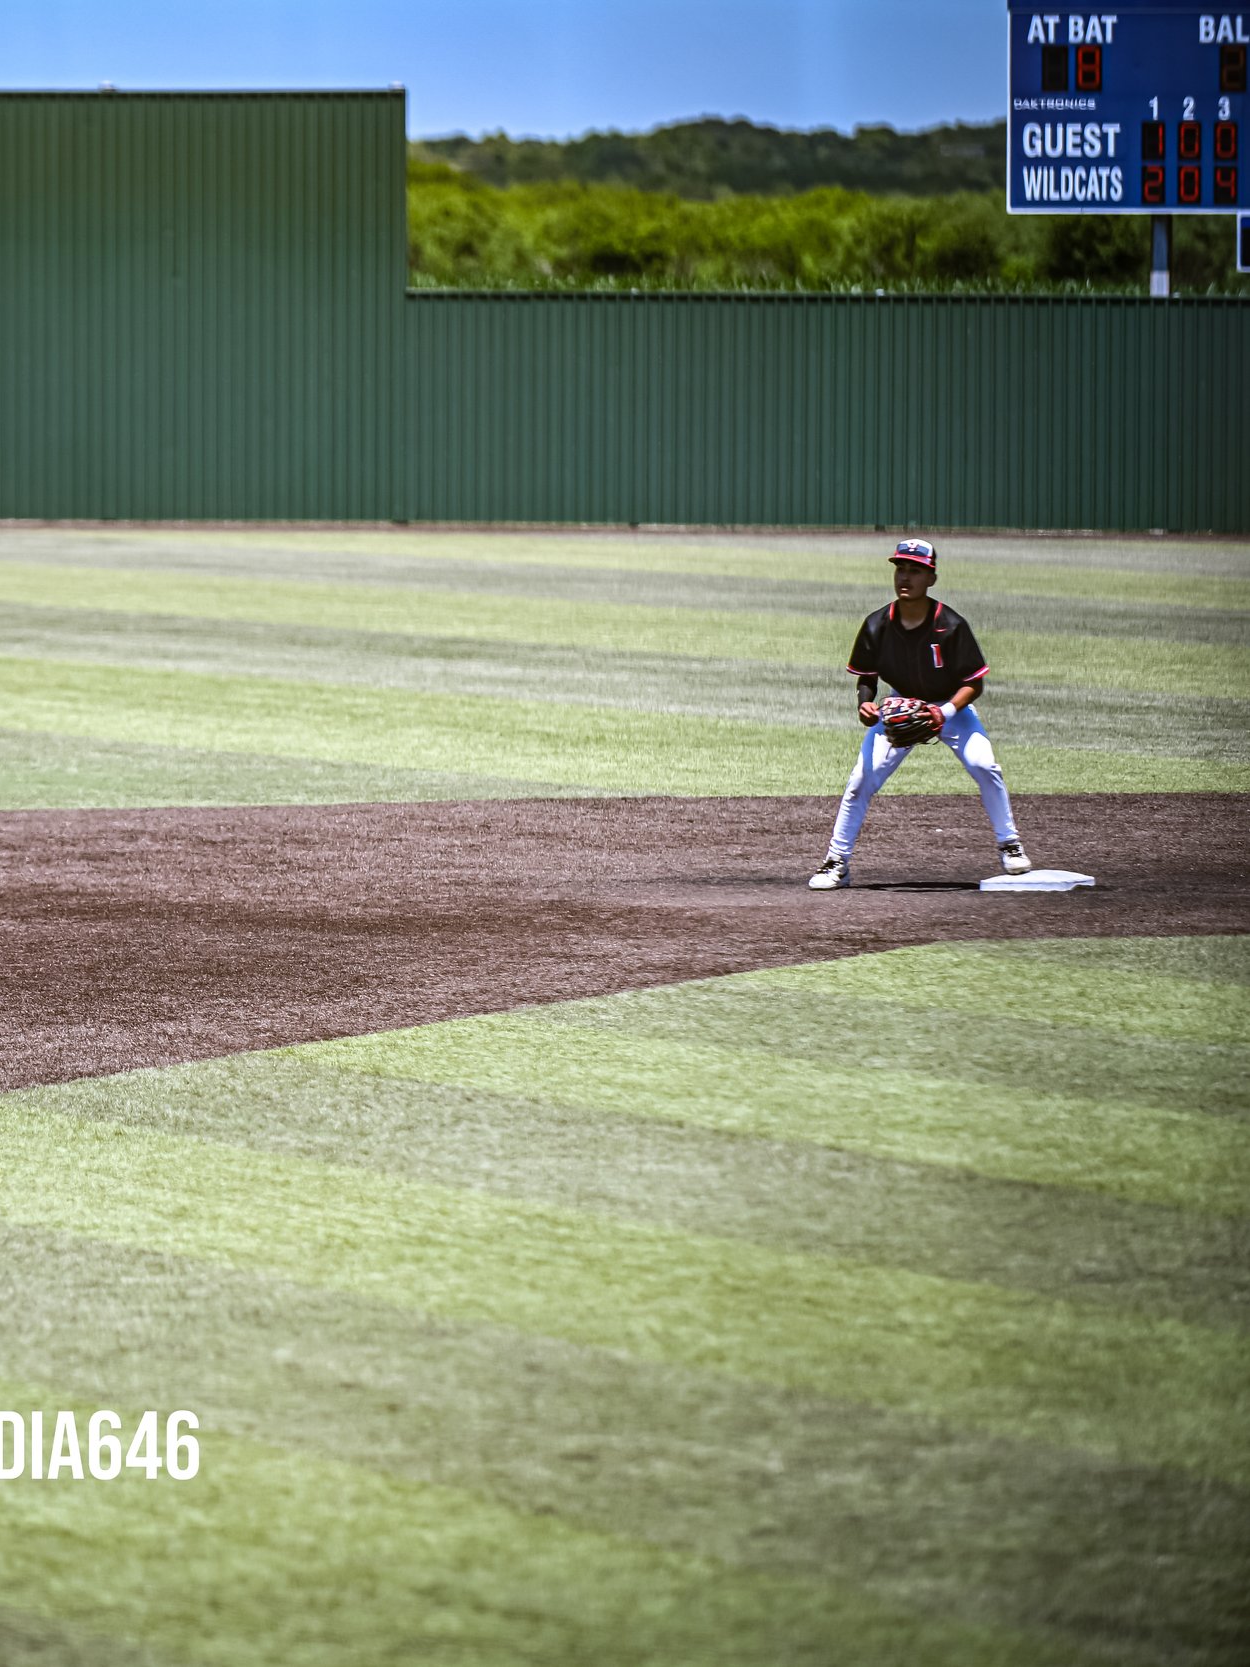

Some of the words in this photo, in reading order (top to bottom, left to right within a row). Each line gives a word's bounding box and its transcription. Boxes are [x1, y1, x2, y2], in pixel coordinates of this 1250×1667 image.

[1027, 15, 1060, 44] AT
[1068, 15, 1118, 44] BAT
[1077, 46, 1101, 90] 8
[1149, 96, 1159, 121] 1
[1182, 96, 1195, 121] 2
[1218, 96, 1231, 121] 3
[1022, 122, 1121, 158] GUEST
[1180, 122, 1199, 158] 0
[1216, 122, 1236, 158] 0
[1022, 166, 1123, 202] WILDCATS
[1144, 165, 1163, 202] 2
[1180, 165, 1199, 202] 0
[1216, 167, 1236, 199] 4
[930, 643, 944, 669] 1
